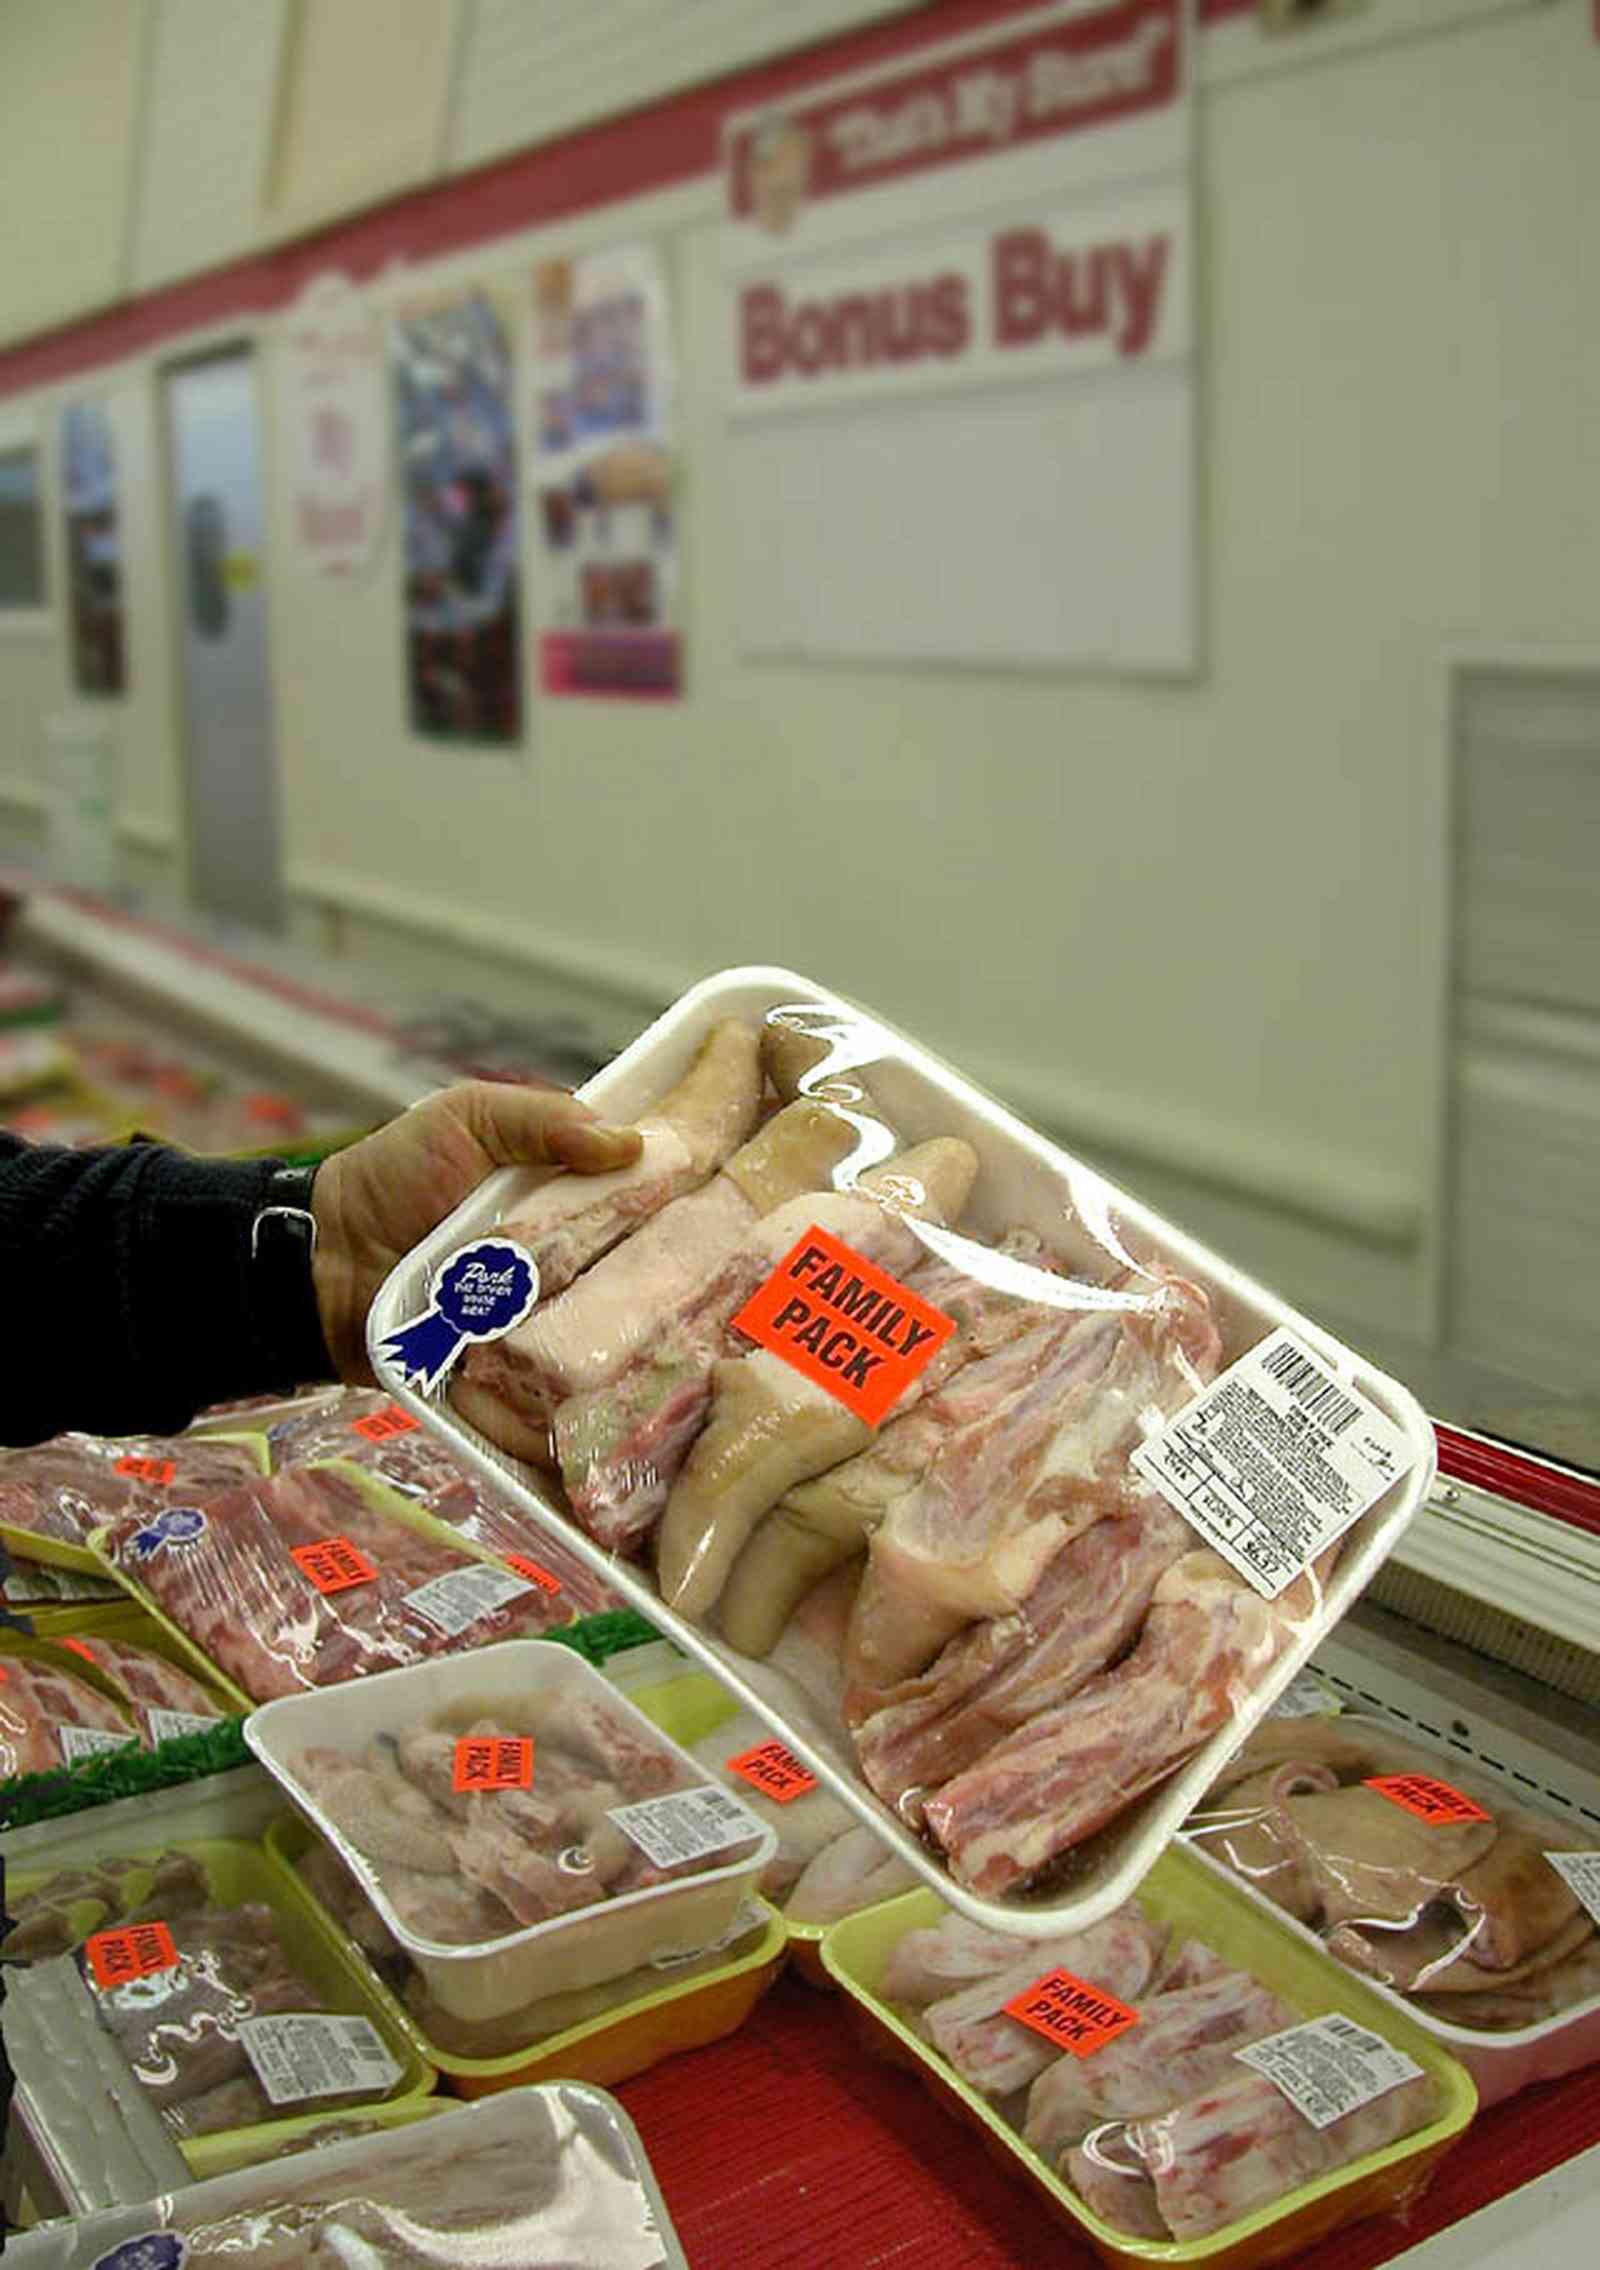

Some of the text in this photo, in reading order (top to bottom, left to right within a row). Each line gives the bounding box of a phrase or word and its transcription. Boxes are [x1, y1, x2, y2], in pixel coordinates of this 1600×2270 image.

[739, 270, 973, 387] Bonus
[991, 225, 1170, 360] Buy
[461, 1262, 516, 1284] Pork
[790, 1245, 935, 1356] FAMILY
[772, 1298, 886, 1389] PACK
[303, 1553, 336, 1583] PACK
[321, 1543, 367, 1581] FAMILY
[464, 1746, 491, 1781] PACK
[495, 1741, 521, 1783] FAMILY
[744, 1759, 797, 1790] PACK
[759, 1743, 815, 1781] FAMILY
[98, 1940, 133, 1976] PACK
[128, 1927, 162, 1971] FAMILY
[1025, 1999, 1097, 2041] PACK
[1040, 1977, 1130, 2029] FAMILY
